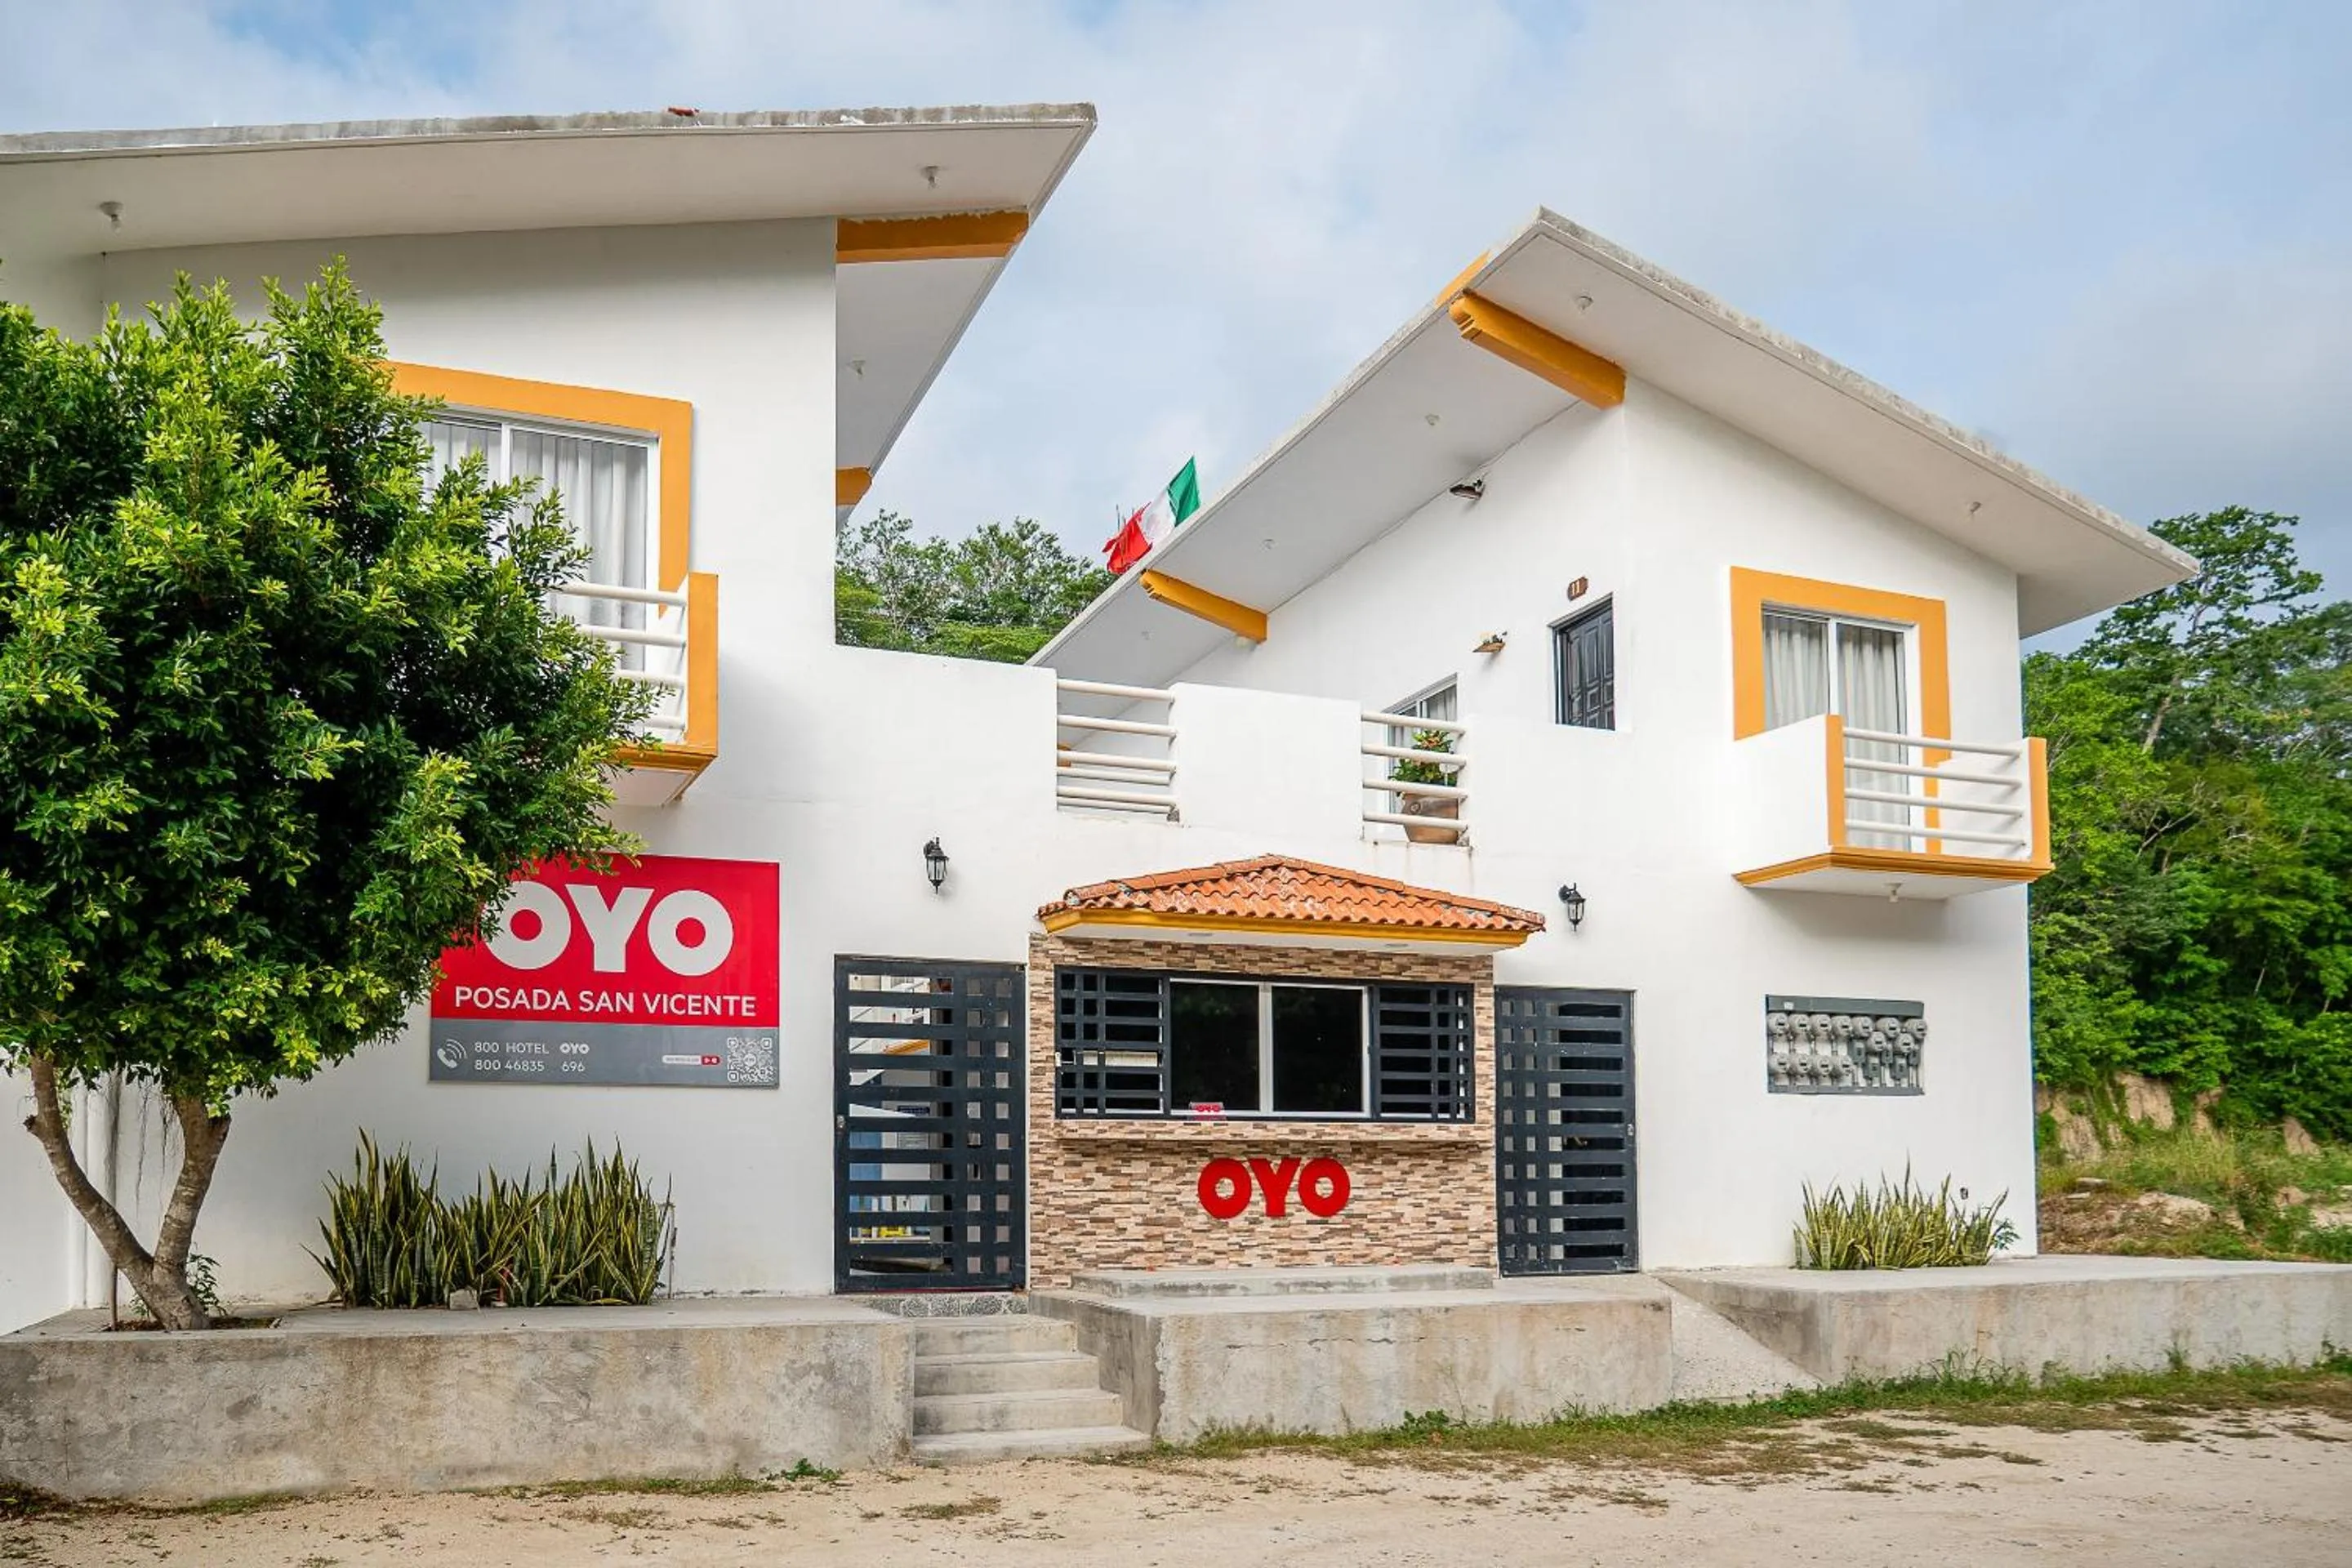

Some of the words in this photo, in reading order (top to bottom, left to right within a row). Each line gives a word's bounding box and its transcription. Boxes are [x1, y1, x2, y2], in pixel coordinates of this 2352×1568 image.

[481, 880, 734, 977] OYO
[455, 986, 571, 1011] POSADA
[578, 990, 635, 1013] SAN
[642, 993, 756, 1017] VICENTE
[474, 1041, 499, 1053] 800
[506, 1042, 550, 1054] HOTEL
[559, 1042, 590, 1054] OYO
[474, 1059, 501, 1071] 800
[504, 1060, 545, 1071] 46835
[561, 1061, 586, 1072] 696
[1197, 1156, 1351, 1219] OYO
